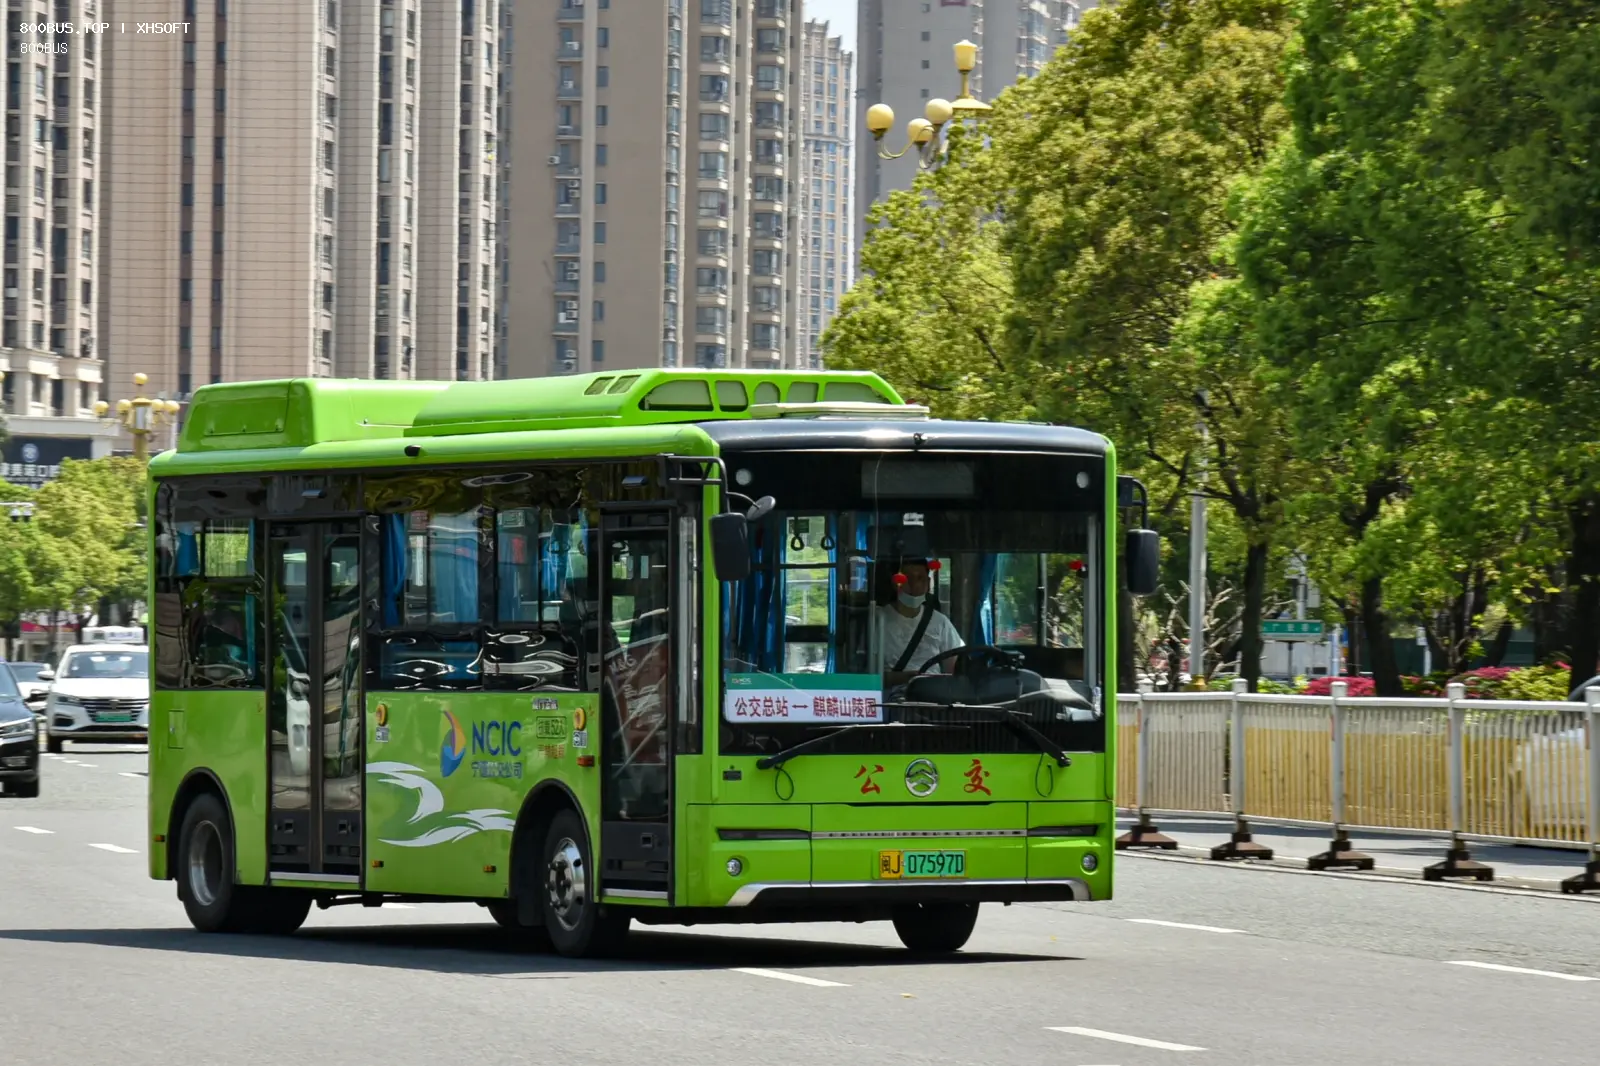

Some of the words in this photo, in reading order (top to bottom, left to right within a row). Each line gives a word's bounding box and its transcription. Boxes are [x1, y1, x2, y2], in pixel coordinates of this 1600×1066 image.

[735, 696, 789, 717] 公交总站
[812, 696, 877, 718] 麒麟山陵园
[472, 720, 522, 756] NCIC
[854, 764, 885, 794] 公
[963, 758, 992, 796] 交
[882, 855, 901, 874] 闽J
[908, 854, 964, 874] 07597D
